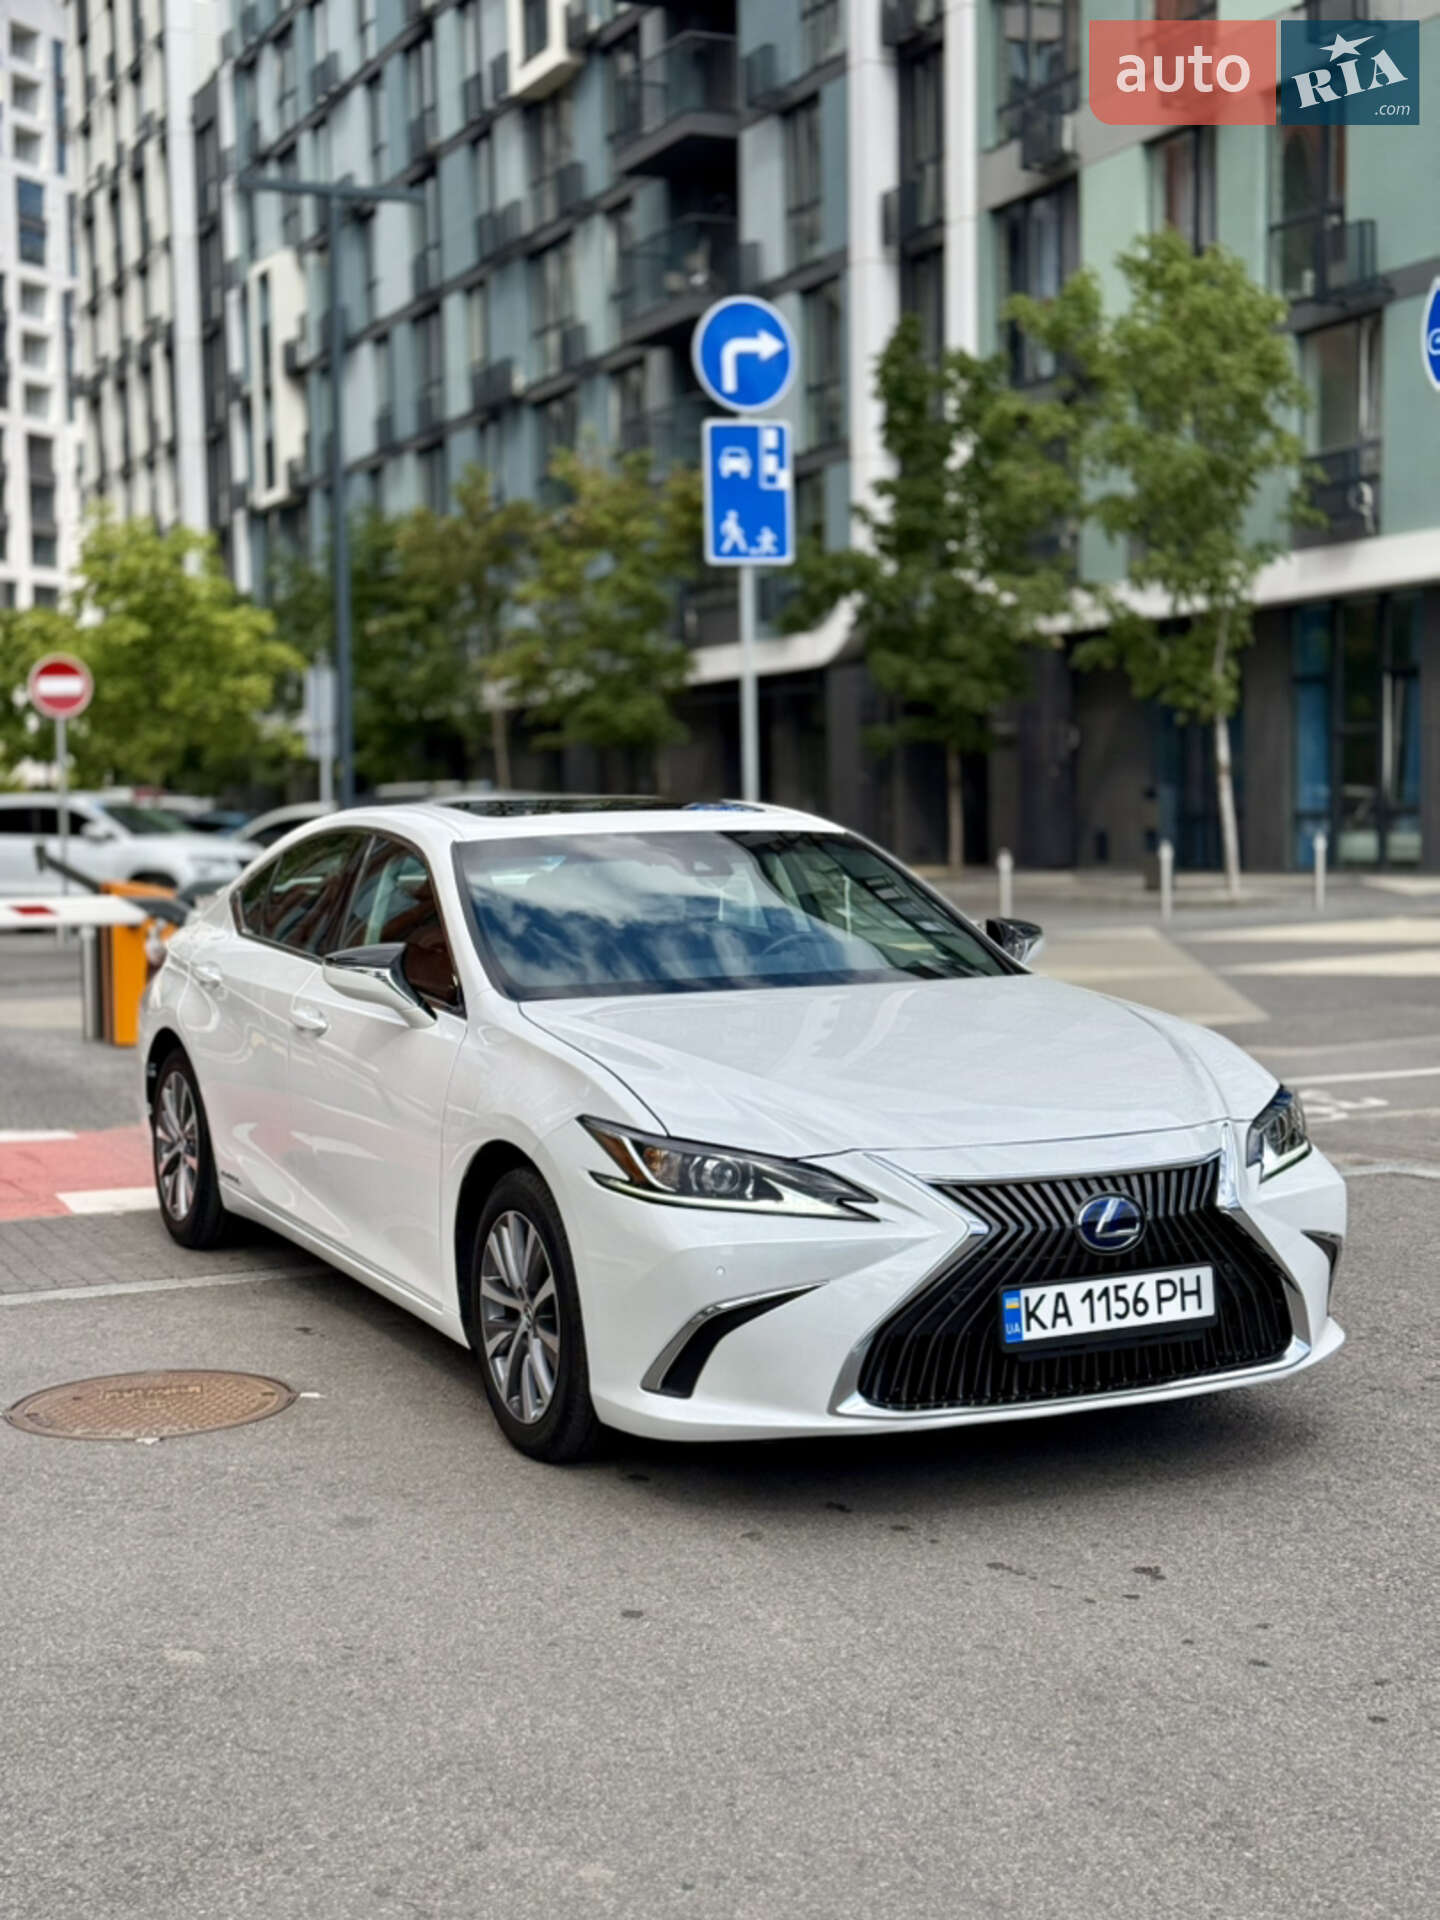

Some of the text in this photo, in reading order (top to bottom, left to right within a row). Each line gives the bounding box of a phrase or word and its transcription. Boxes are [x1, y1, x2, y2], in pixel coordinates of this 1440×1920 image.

[1023, 1275, 1203, 1332] KA 1156 PH
[1005, 1322, 1021, 1336] UA
